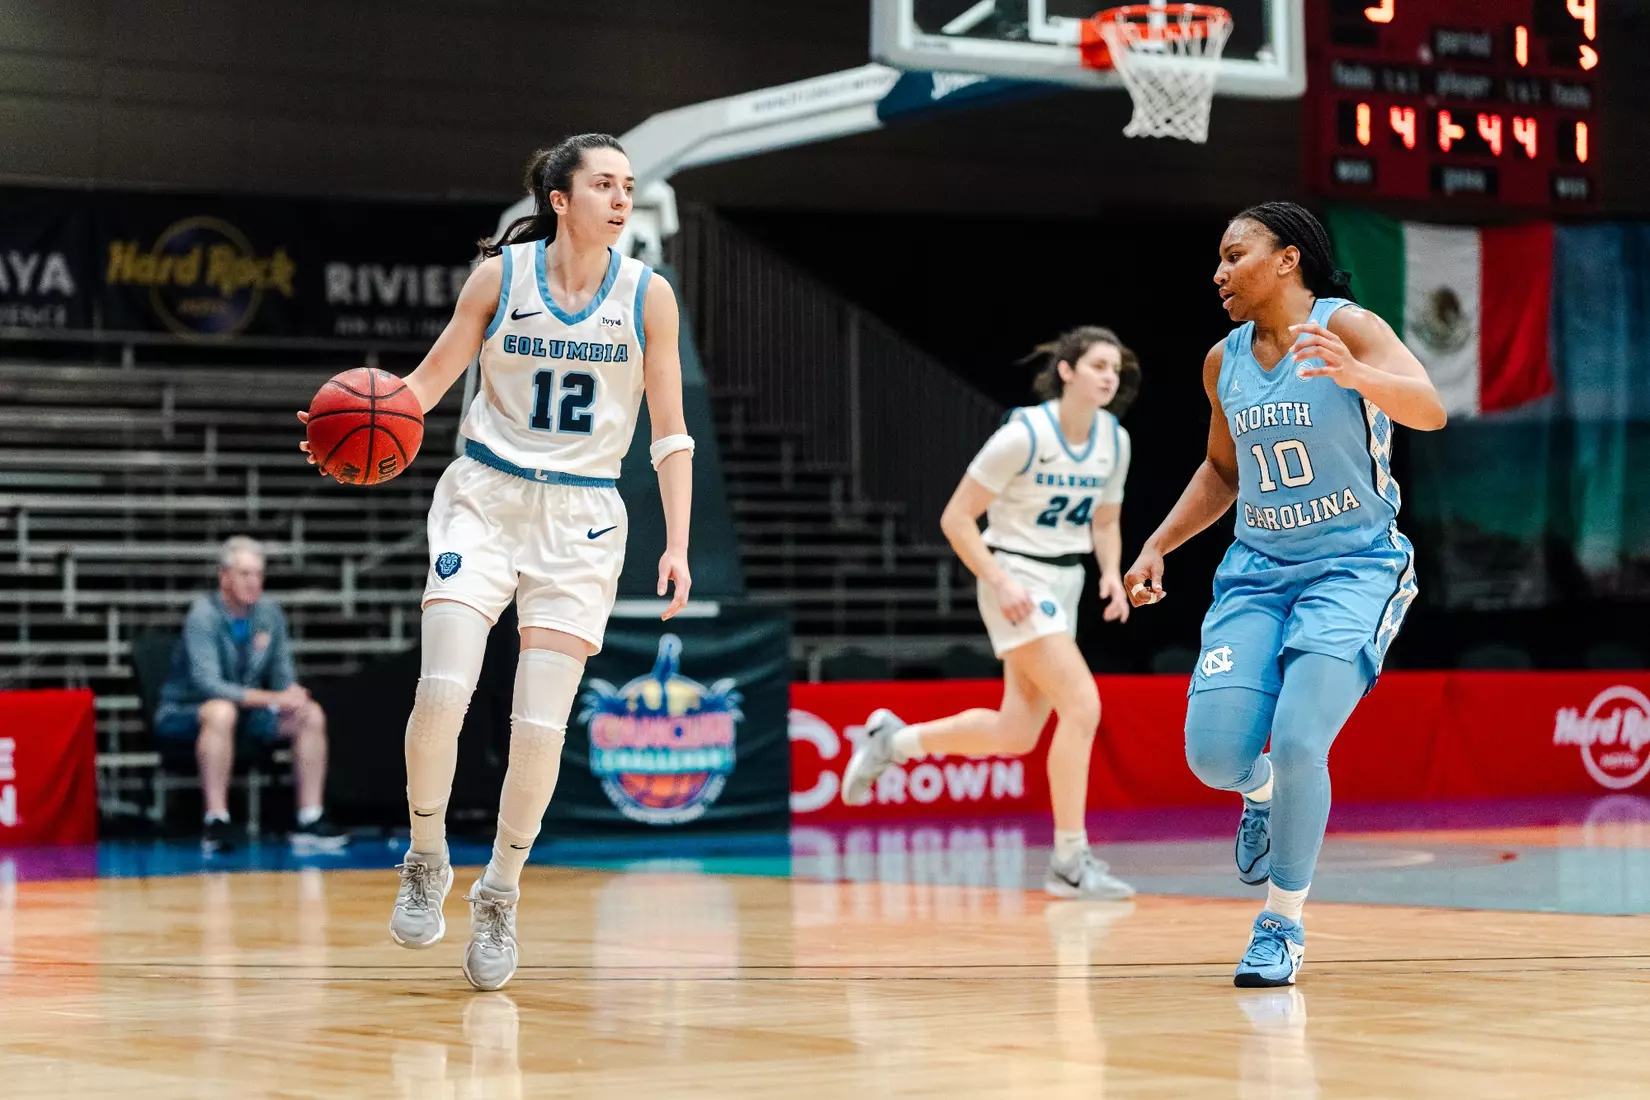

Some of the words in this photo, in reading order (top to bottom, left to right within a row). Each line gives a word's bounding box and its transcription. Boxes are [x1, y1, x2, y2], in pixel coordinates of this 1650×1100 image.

[106, 240, 203, 286] Hard
[206, 243, 296, 299] Rock
[504, 334, 629, 362] COLUMBIA
[528, 367, 598, 436] 12
[1235, 401, 1313, 436] NORTH
[1250, 439, 1316, 493] 10
[1036, 495, 1094, 528] 24
[1244, 487, 1361, 531] CAROLINA
[858, 760, 1025, 806] ROWN
